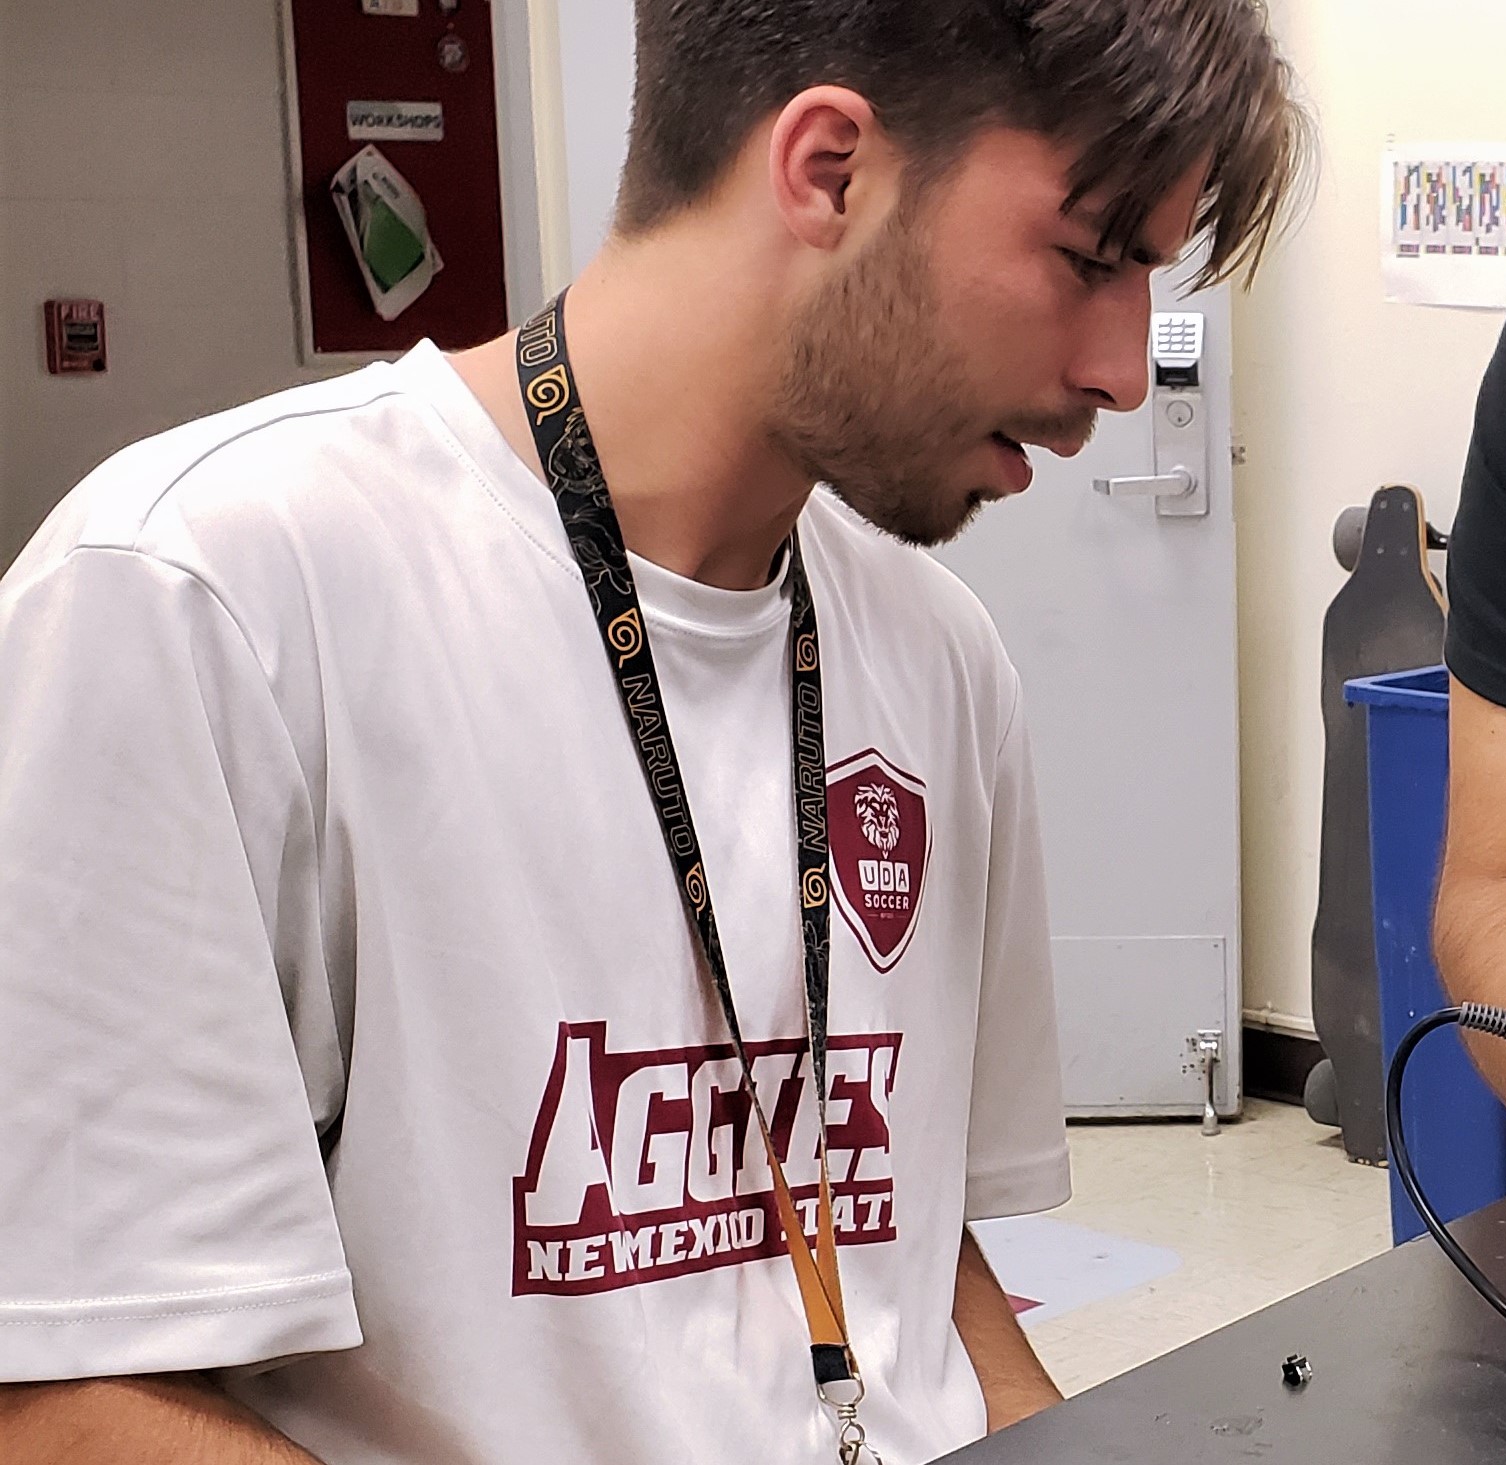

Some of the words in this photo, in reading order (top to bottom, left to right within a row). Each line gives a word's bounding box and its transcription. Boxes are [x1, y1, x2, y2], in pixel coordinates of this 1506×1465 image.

[350, 112, 441, 129] WORKSHOPS
[622, 673, 697, 857] NARUTO
[798, 682, 828, 853] NARUTO
[863, 866, 908, 888] UDA
[864, 893, 909, 910] SOCCER
[525, 1035, 894, 1227] AGGIES
[781, 1192, 896, 1242] TAT
